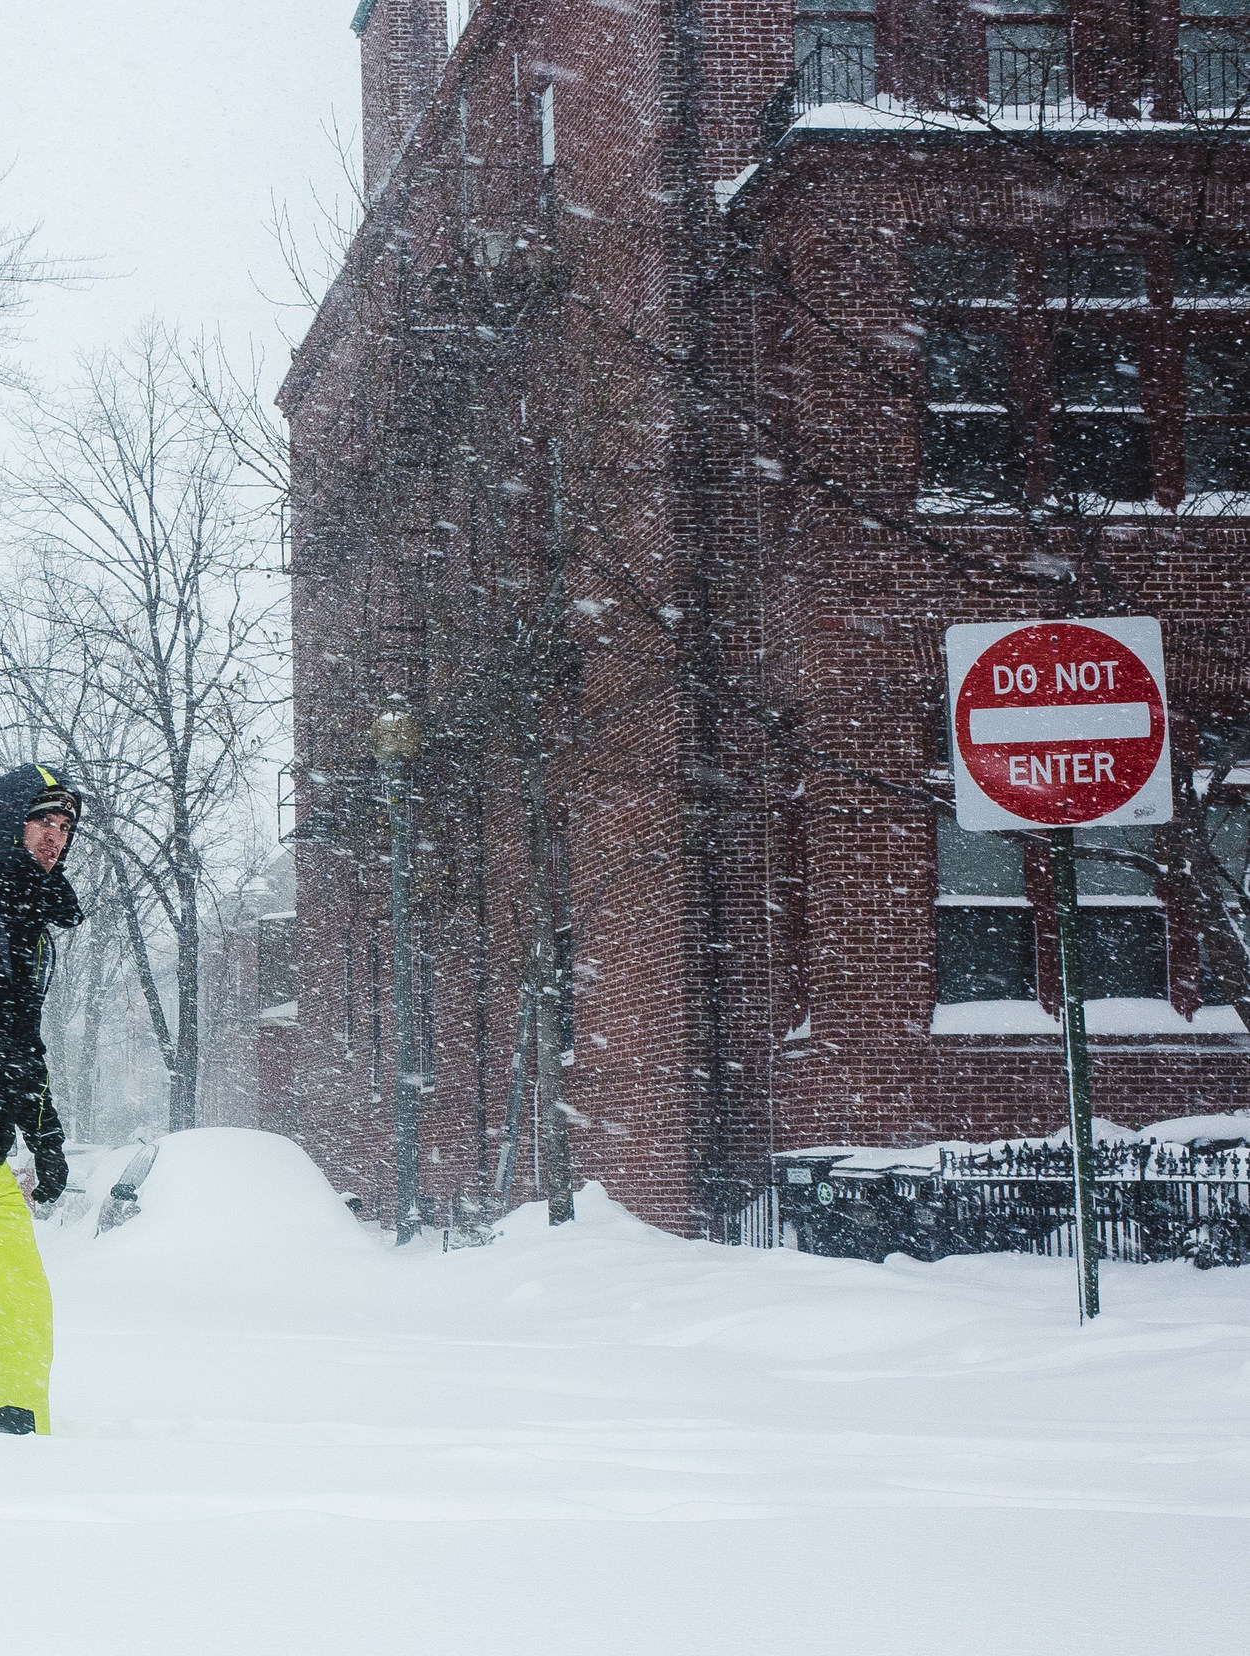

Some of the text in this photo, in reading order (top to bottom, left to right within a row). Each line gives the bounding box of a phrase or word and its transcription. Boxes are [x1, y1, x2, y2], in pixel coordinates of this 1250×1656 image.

[993, 661, 1118, 694] DO NOT
[1010, 752, 1115, 785] ENTER
